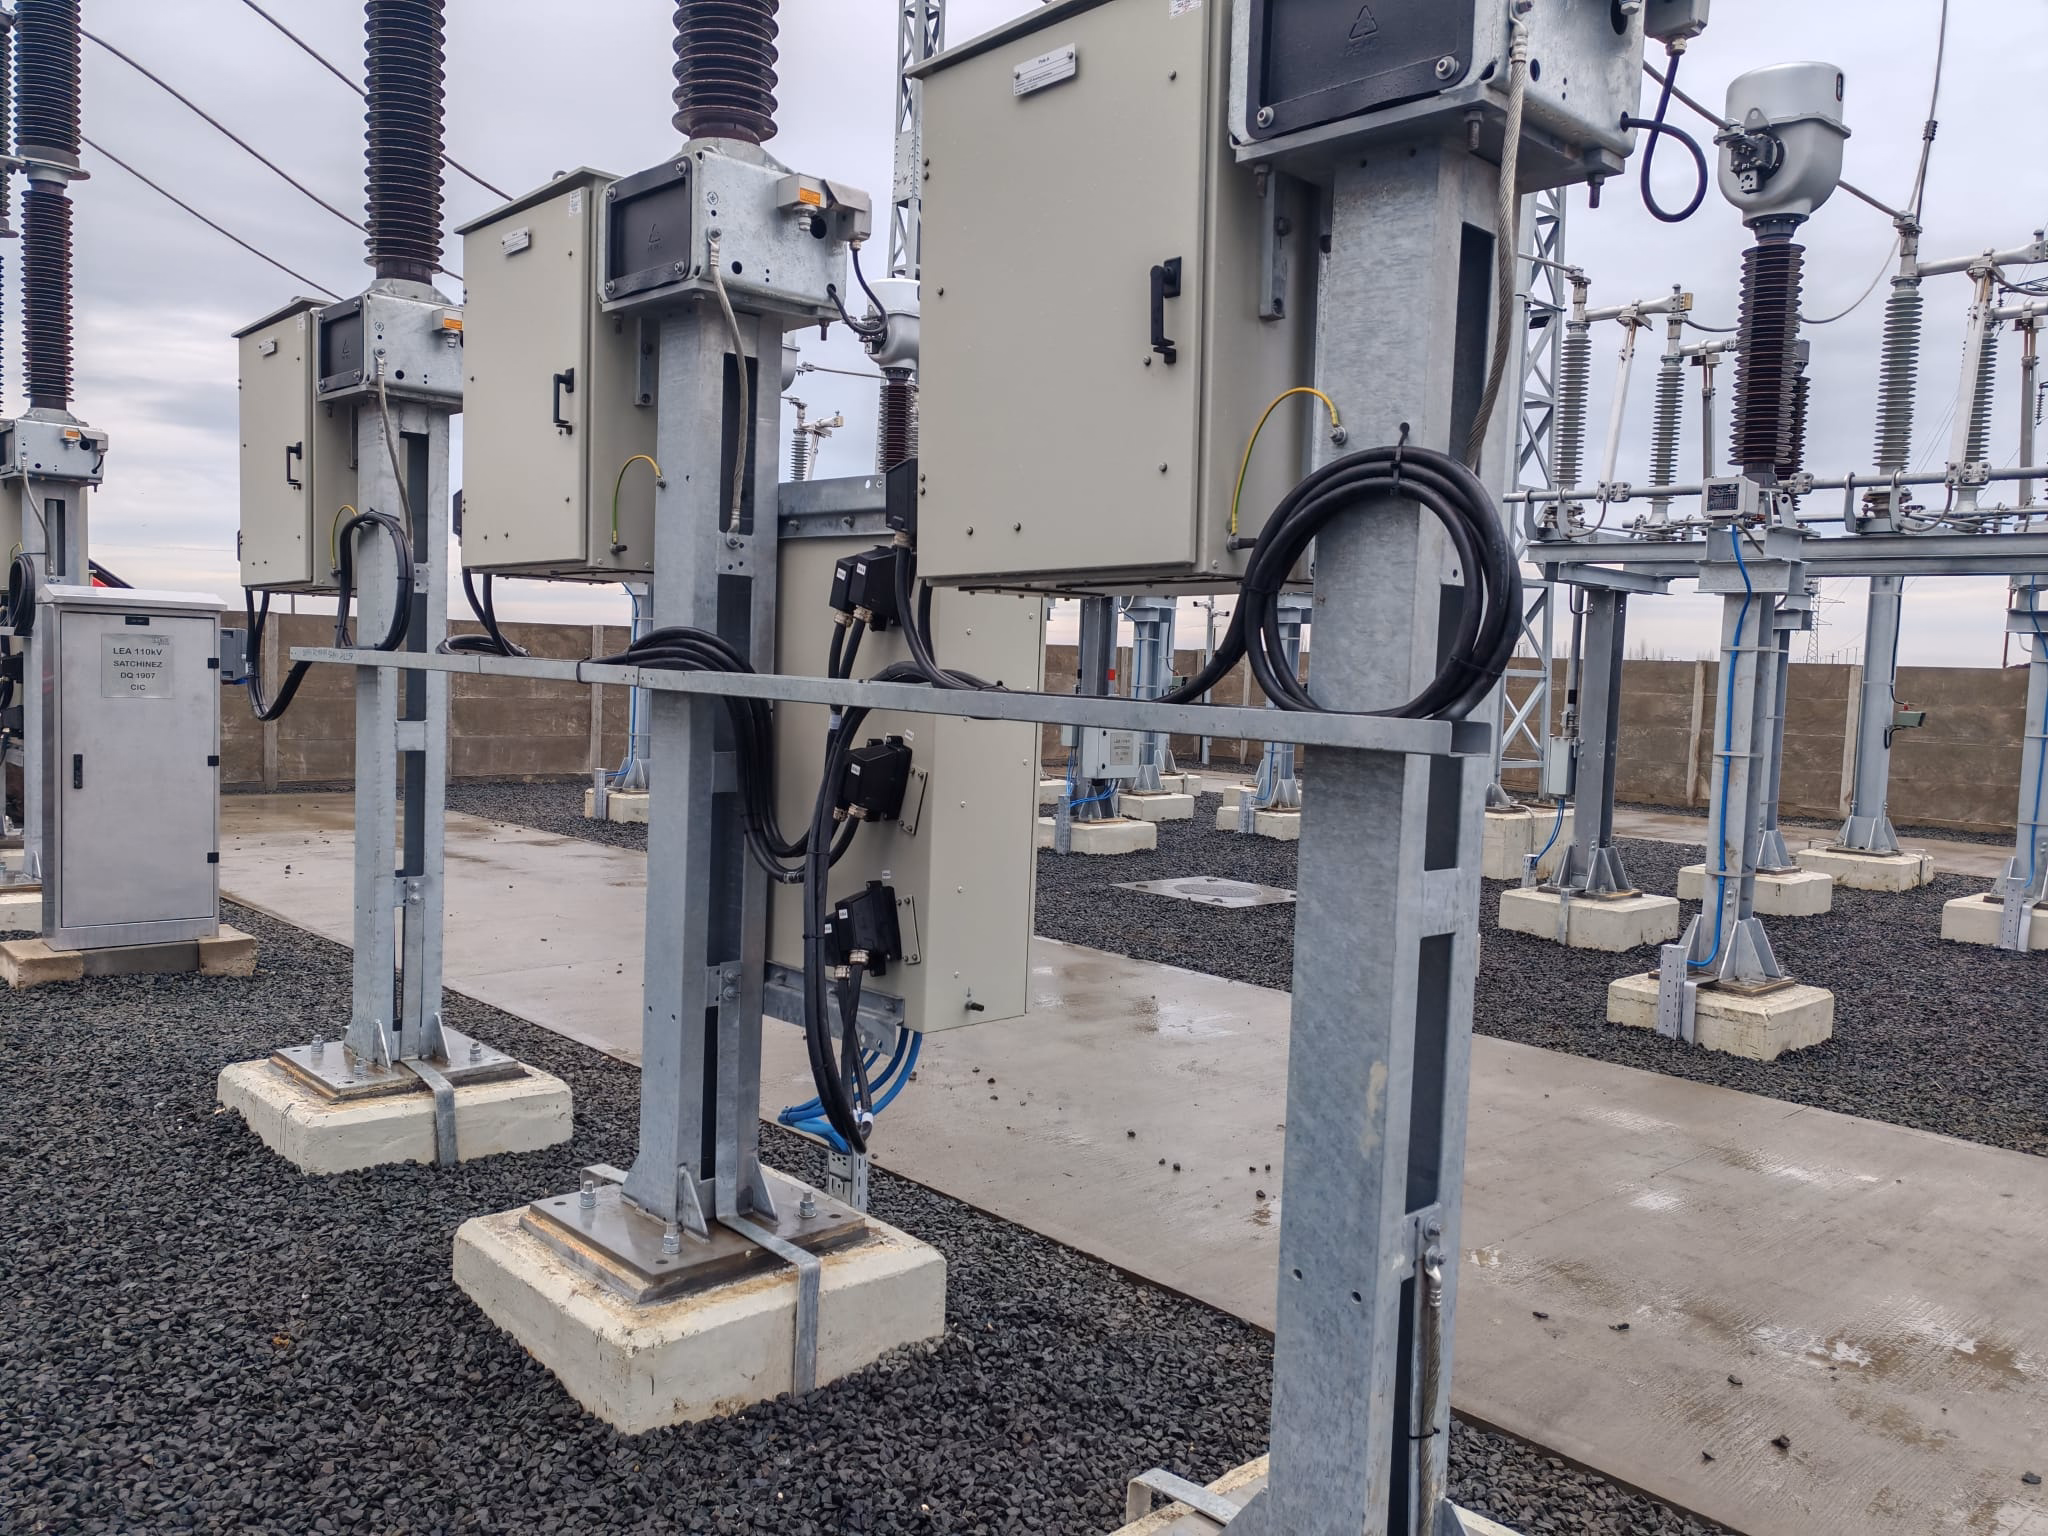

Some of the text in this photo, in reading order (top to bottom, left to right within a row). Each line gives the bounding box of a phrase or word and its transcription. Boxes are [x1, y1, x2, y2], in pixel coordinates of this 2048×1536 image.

[113, 647, 163, 656] LEA 110kV
[113, 660, 163, 668] SATCHINEZ
